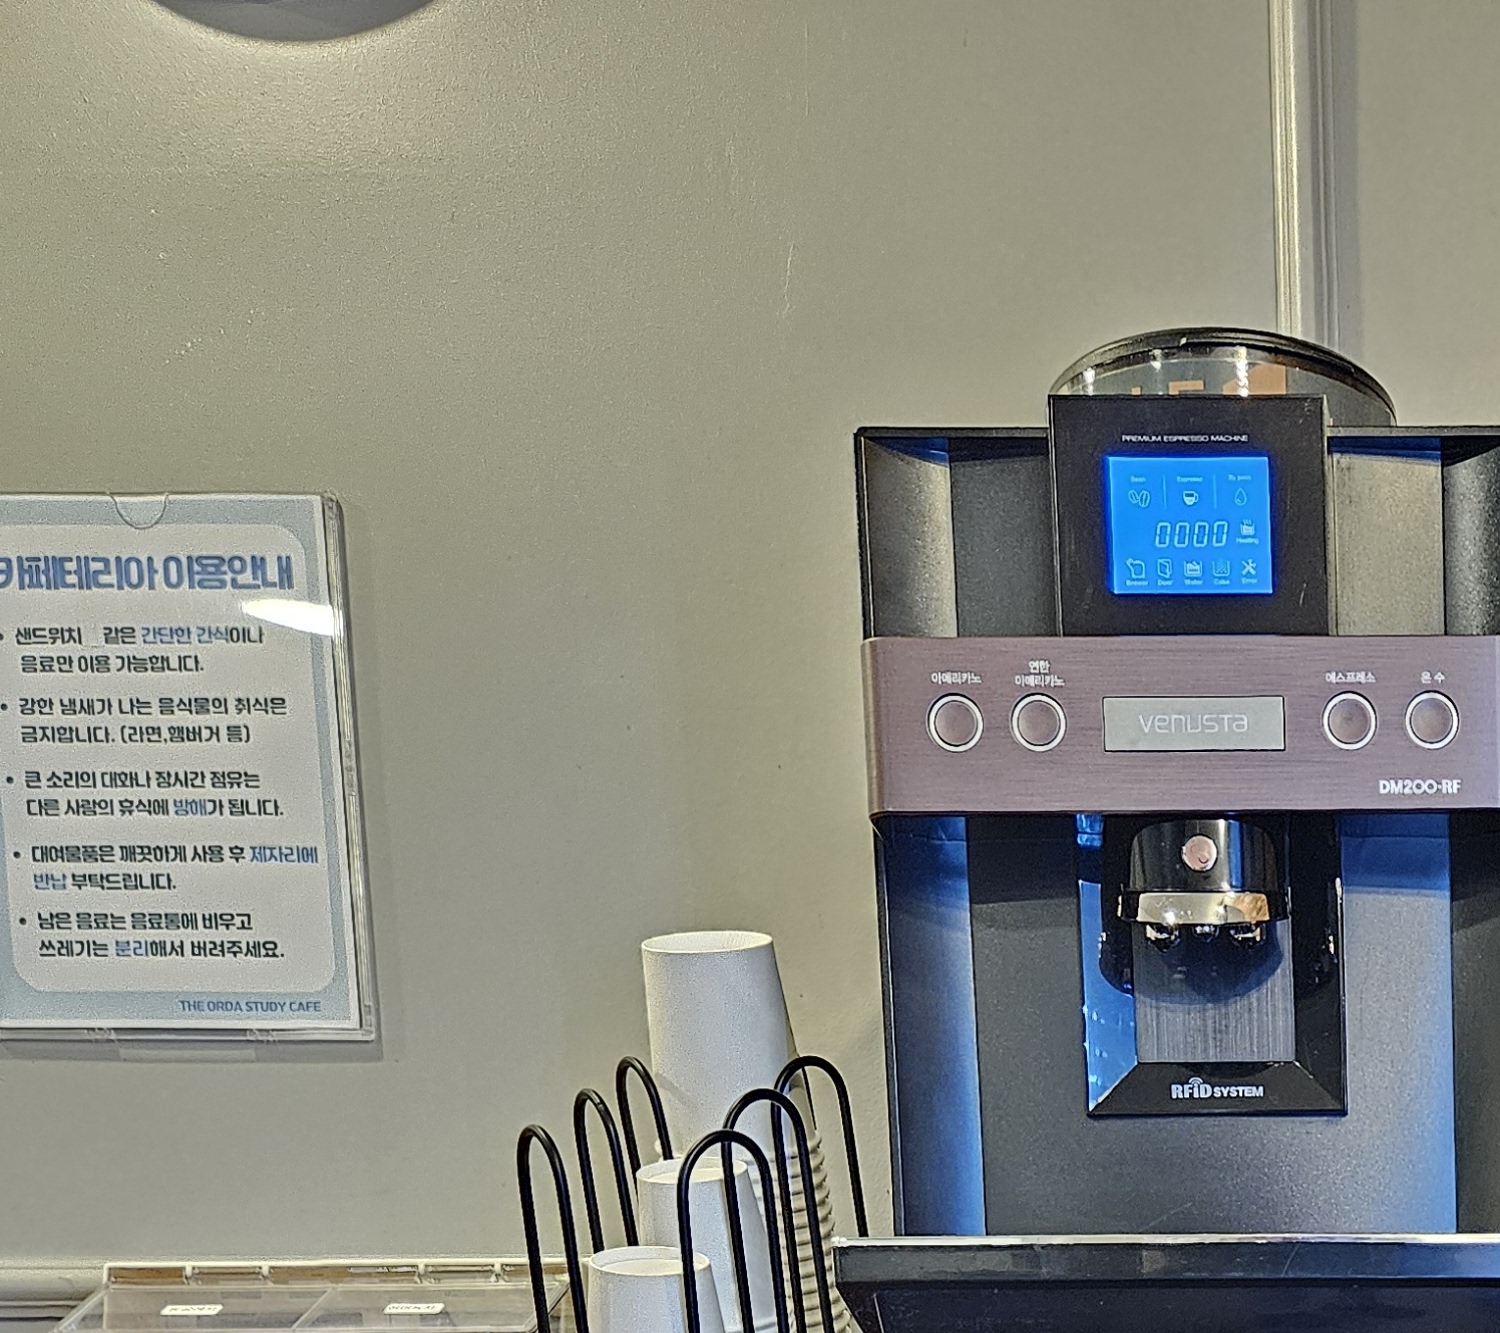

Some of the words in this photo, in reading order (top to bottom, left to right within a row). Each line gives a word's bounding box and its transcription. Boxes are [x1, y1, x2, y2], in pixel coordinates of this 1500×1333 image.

[1121, 434, 1161, 442] PREMIUM
[1164, 434, 1208, 442] ESPRESSO
[1211, 434, 1248, 442] MACHINE
[1155, 521, 1228, 548] 0000
[0, 556, 157, 590] 카페테리아
[163, 556, 294, 590] 이용안내
[15, 626, 82, 645] 샌드위치
[103, 626, 137, 645] 같은
[141, 627, 192, 644] 간단한
[196, 626, 264, 644] 간식이나
[20, 655, 73, 673] 음료만
[77, 655, 111, 673] 이용
[115, 655, 204, 673] 가능합니다.
[1029, 660, 1050, 674] 연한
[931, 672, 982, 684] 아메리카노
[1015, 674, 1065, 687] 아메리카노
[1325, 671, 1376, 683] 에스프레소
[19, 697, 54, 716] 강한
[59, 697, 113, 716] 냄새가
[118, 697, 152, 716] 나는
[158, 697, 228, 716] 음식물의
[234, 697, 287, 716] 취식은
[20, 725, 116, 744] 금지합니다.
[120, 725, 220, 744] (라면,햄버거
[226, 724, 251, 744] 등)
[25, 770, 42, 789] 큰
[46, 770, 97, 789] 소리의
[101, 770, 152, 789] 대화나
[155, 770, 206, 789] 장시간
[210, 771, 261, 789] 점유는
[26, 799, 60, 817] 다른
[64, 798, 114, 817] 사람의
[119, 798, 170, 817] 휴식에
[173, 799, 224, 817] 방해가
[228, 799, 284, 817] 됩니다.
[31, 845, 116, 864] 대여물품은
[119, 845, 187, 864] 깨끗하게
[191, 845, 225, 864] 사용
[229, 845, 246, 864] 후
[250, 846, 319, 864] 제자리에
[33, 873, 67, 891] 반납
[71, 873, 177, 891] 부탁드립니다.
[38, 912, 72, 931] 남은
[76, 912, 127, 931] 음료는
[131, 912, 198, 931] 음료통에
[202, 912, 253, 931] 비우고
[39, 941, 109, 959] 쓰레기는
[115, 940, 185, 959] 분리해서
[190, 940, 284, 959] 버려주세요.
[180, 1000, 205, 1012] THE
[207, 1000, 243, 1012] ORDA
[245, 1000, 286, 1013] STUDY
[289, 1001, 321, 1012] CAFE
[1213, 1086, 1263, 1098] SYSTEM
